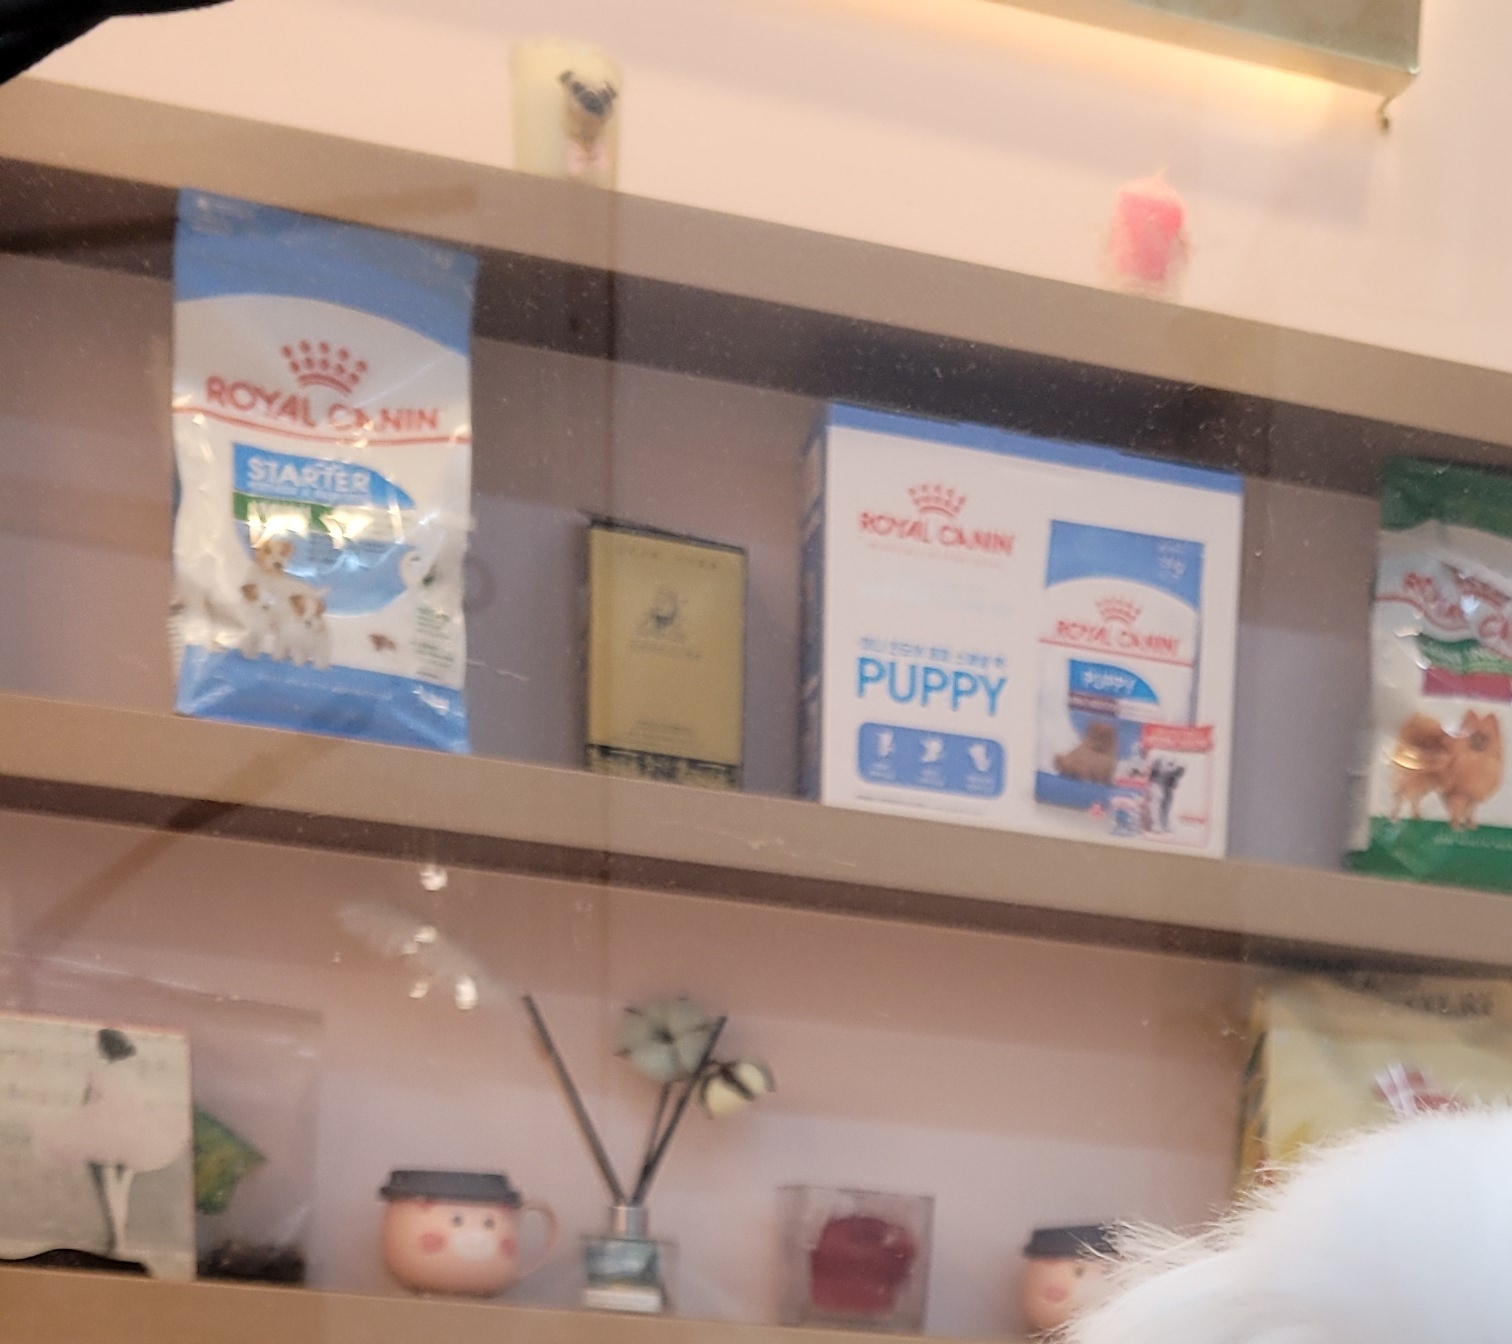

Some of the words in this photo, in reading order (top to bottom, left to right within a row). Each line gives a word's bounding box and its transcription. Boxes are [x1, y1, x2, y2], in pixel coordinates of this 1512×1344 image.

[206, 375, 317, 430] ROYAL
[328, 402, 439, 431] CANIN
[248, 457, 371, 495] STARTER
[860, 512, 931, 544] ROYAL
[857, 655, 1008, 717] PUPPY
